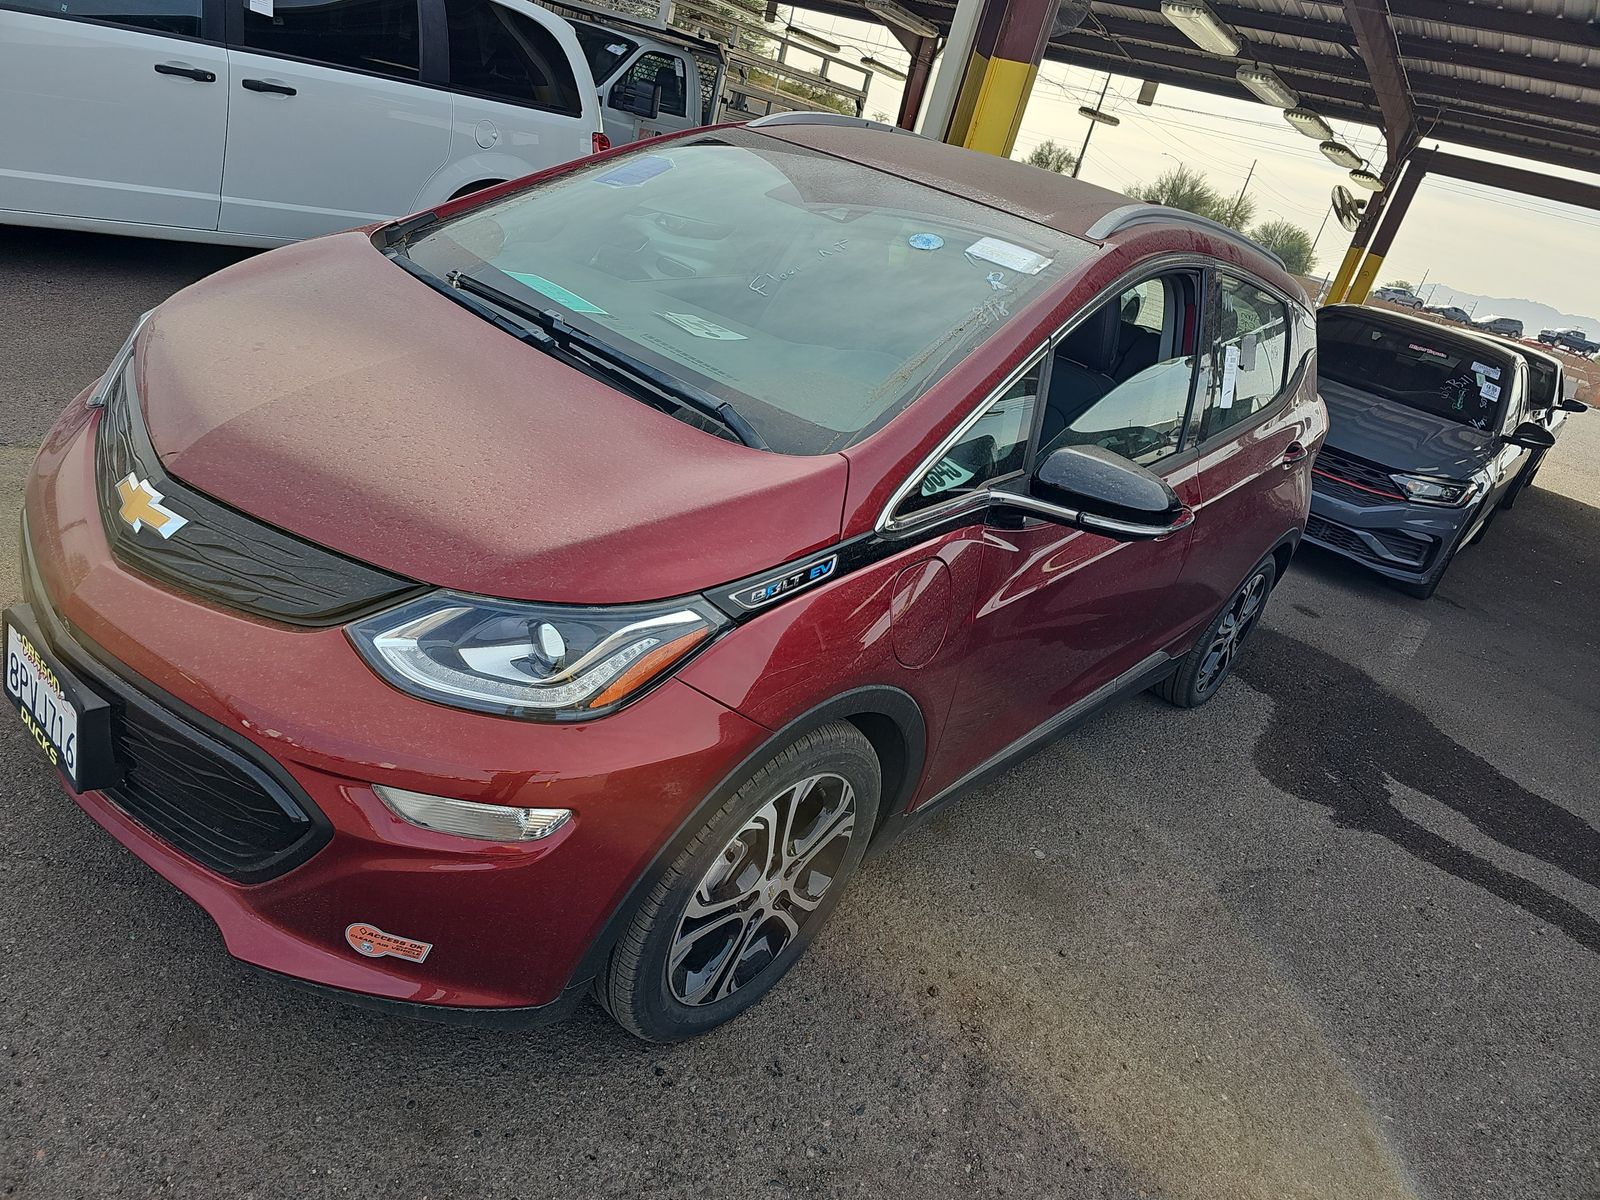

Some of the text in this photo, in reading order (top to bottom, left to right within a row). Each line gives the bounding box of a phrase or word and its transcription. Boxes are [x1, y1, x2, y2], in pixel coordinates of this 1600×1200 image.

[809, 560, 832, 580] EV
[10, 652, 75, 769] 8PVJ716
[20, 705, 59, 766] DUCKS
[350, 934, 374, 943] CLEAN
[391, 946, 420, 955] VEHICLE
[367, 932, 406, 945] ACCESS
